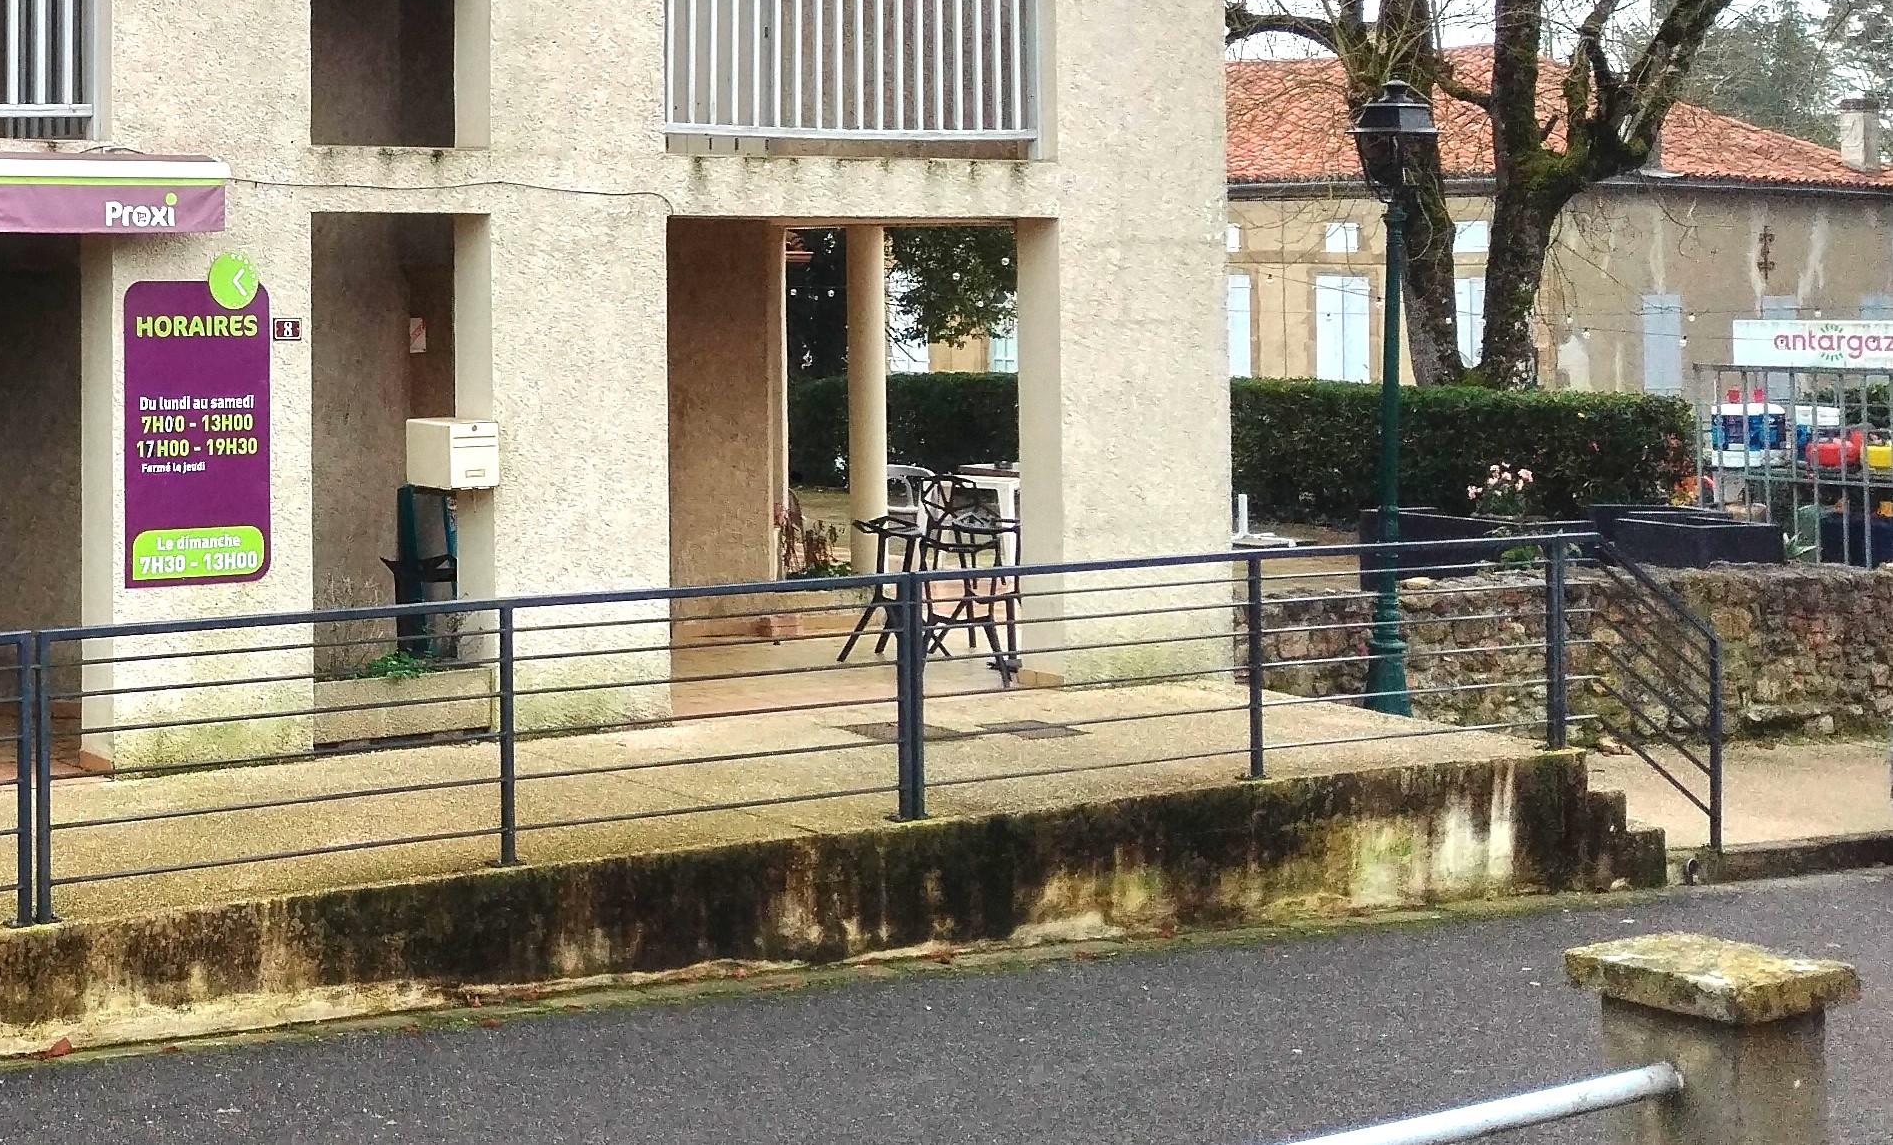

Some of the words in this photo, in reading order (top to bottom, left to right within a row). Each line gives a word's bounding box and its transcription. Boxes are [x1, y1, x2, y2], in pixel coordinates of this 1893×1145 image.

[106, 193, 177, 227] Proxi
[136, 315, 258, 337] HORAIRES
[1773, 330, 1893, 359] antargaz
[139, 396, 157, 411] Du
[159, 395, 191, 410] lundi
[193, 398, 208, 410] au
[210, 394, 255, 409] samedi
[141, 415, 185, 434] 7H00
[202, 414, 254, 432] 13H00
[136, 439, 190, 459] 17H00
[206, 437, 258, 456] 19H30
[182, 462, 206, 474] jeudi
[157, 537, 174, 551] Le
[177, 534, 241, 550] dimanche
[139, 555, 186, 574] 7H30
[203, 551, 258, 571] 13H00
